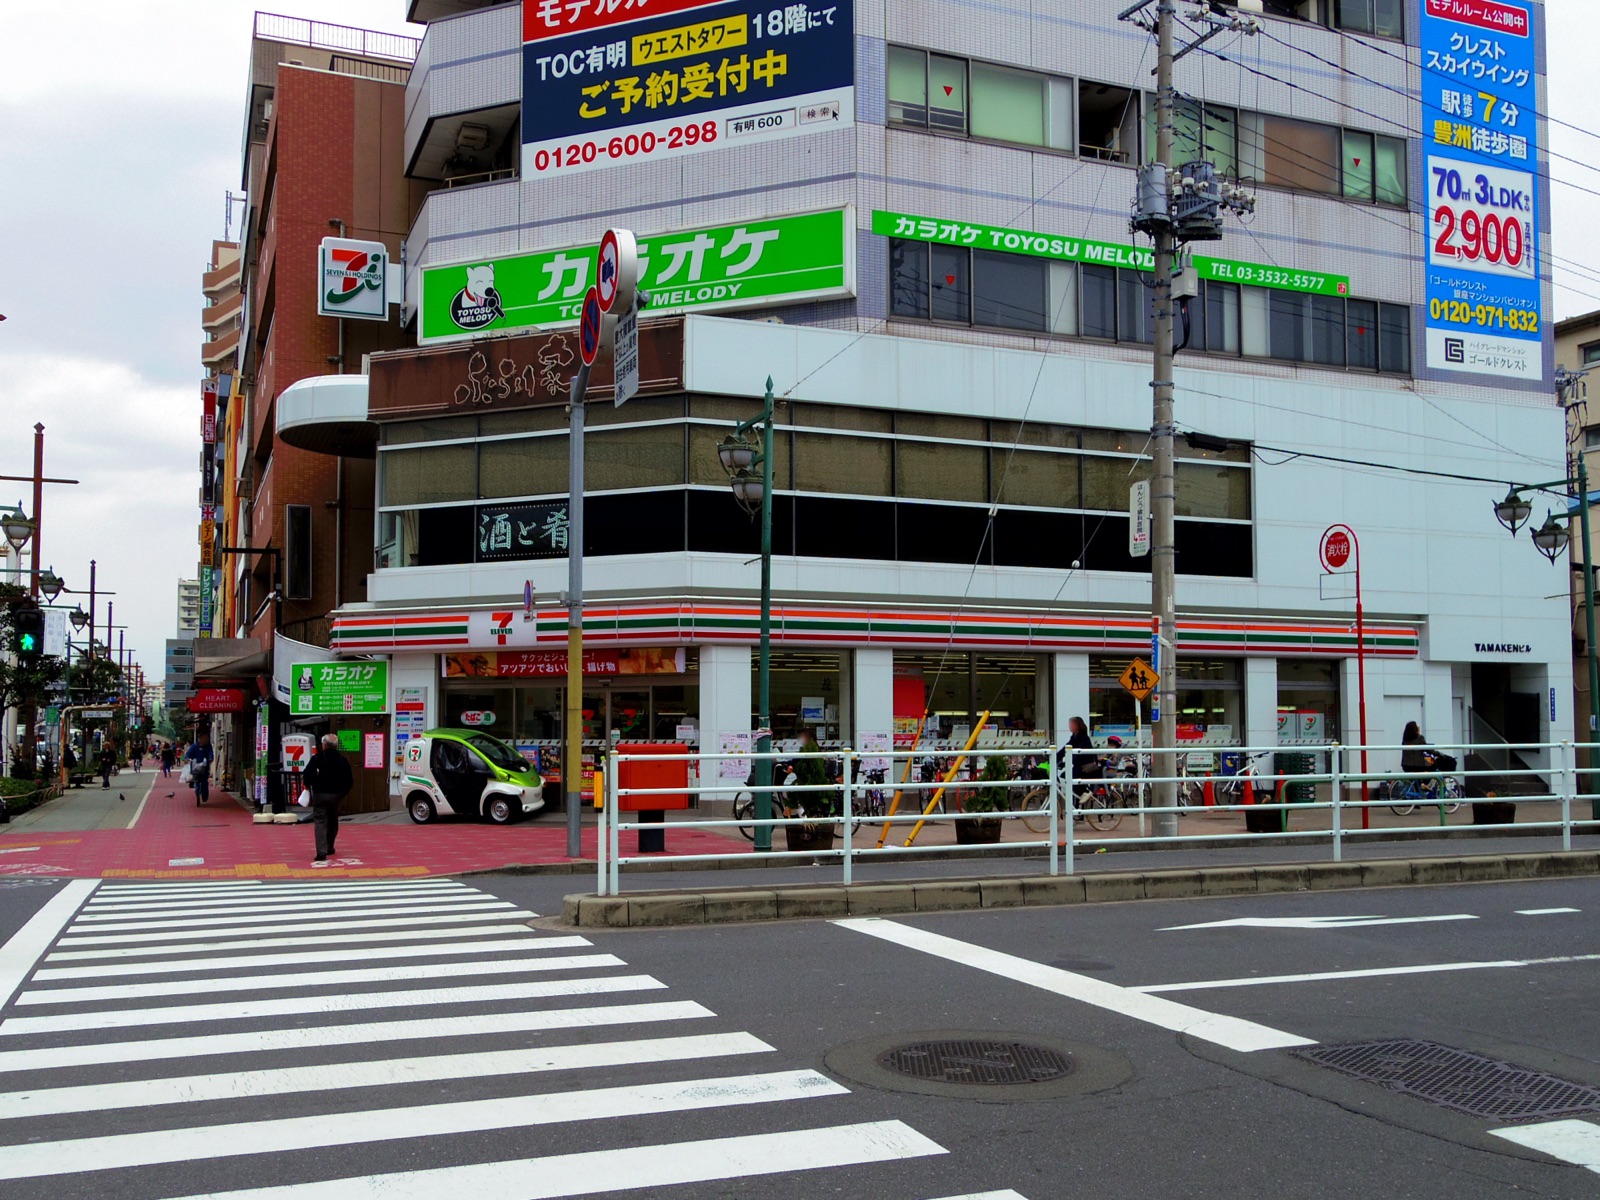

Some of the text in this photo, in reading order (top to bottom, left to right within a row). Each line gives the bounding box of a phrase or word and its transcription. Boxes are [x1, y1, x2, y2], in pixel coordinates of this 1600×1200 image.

[536, 5, 837, 81] TOC有明 ウエストタワー 18階にて
[1450, 32, 1506, 60] クレスト
[578, 49, 788, 119] ご予約受付中
[1427, 50, 1529, 87] スカイウイング
[733, 115, 783, 134] 有明 600
[1433, 119, 1527, 160] 豊洲徒歩圏
[534, 120, 718, 171] 0120-600-298
[1475, 174, 1523, 211] 3LDK
[894, 217, 982, 243] カラオケ
[989, 230, 1080, 257] TOYOSU
[1084, 245, 1156, 267] MELOD
[1211, 262, 1233, 278] TEL
[1236, 266, 1325, 290] 03-3532-5577
[1434, 205, 1523, 267] 2,900
[537, 228, 780, 301] カオケ
[457, 306, 492, 317] TOYOSU
[652, 283, 743, 307] MELODY
[459, 313, 494, 324] MELODY
[1430, 298, 1538, 332] 0120-971-832
[1469, 354, 1527, 372] ゴールドクレスト
[479, 508, 570, 552] 酒と肴
[1327, 541, 1348, 557] 消火栓
[320, 665, 377, 681] カラオケ
